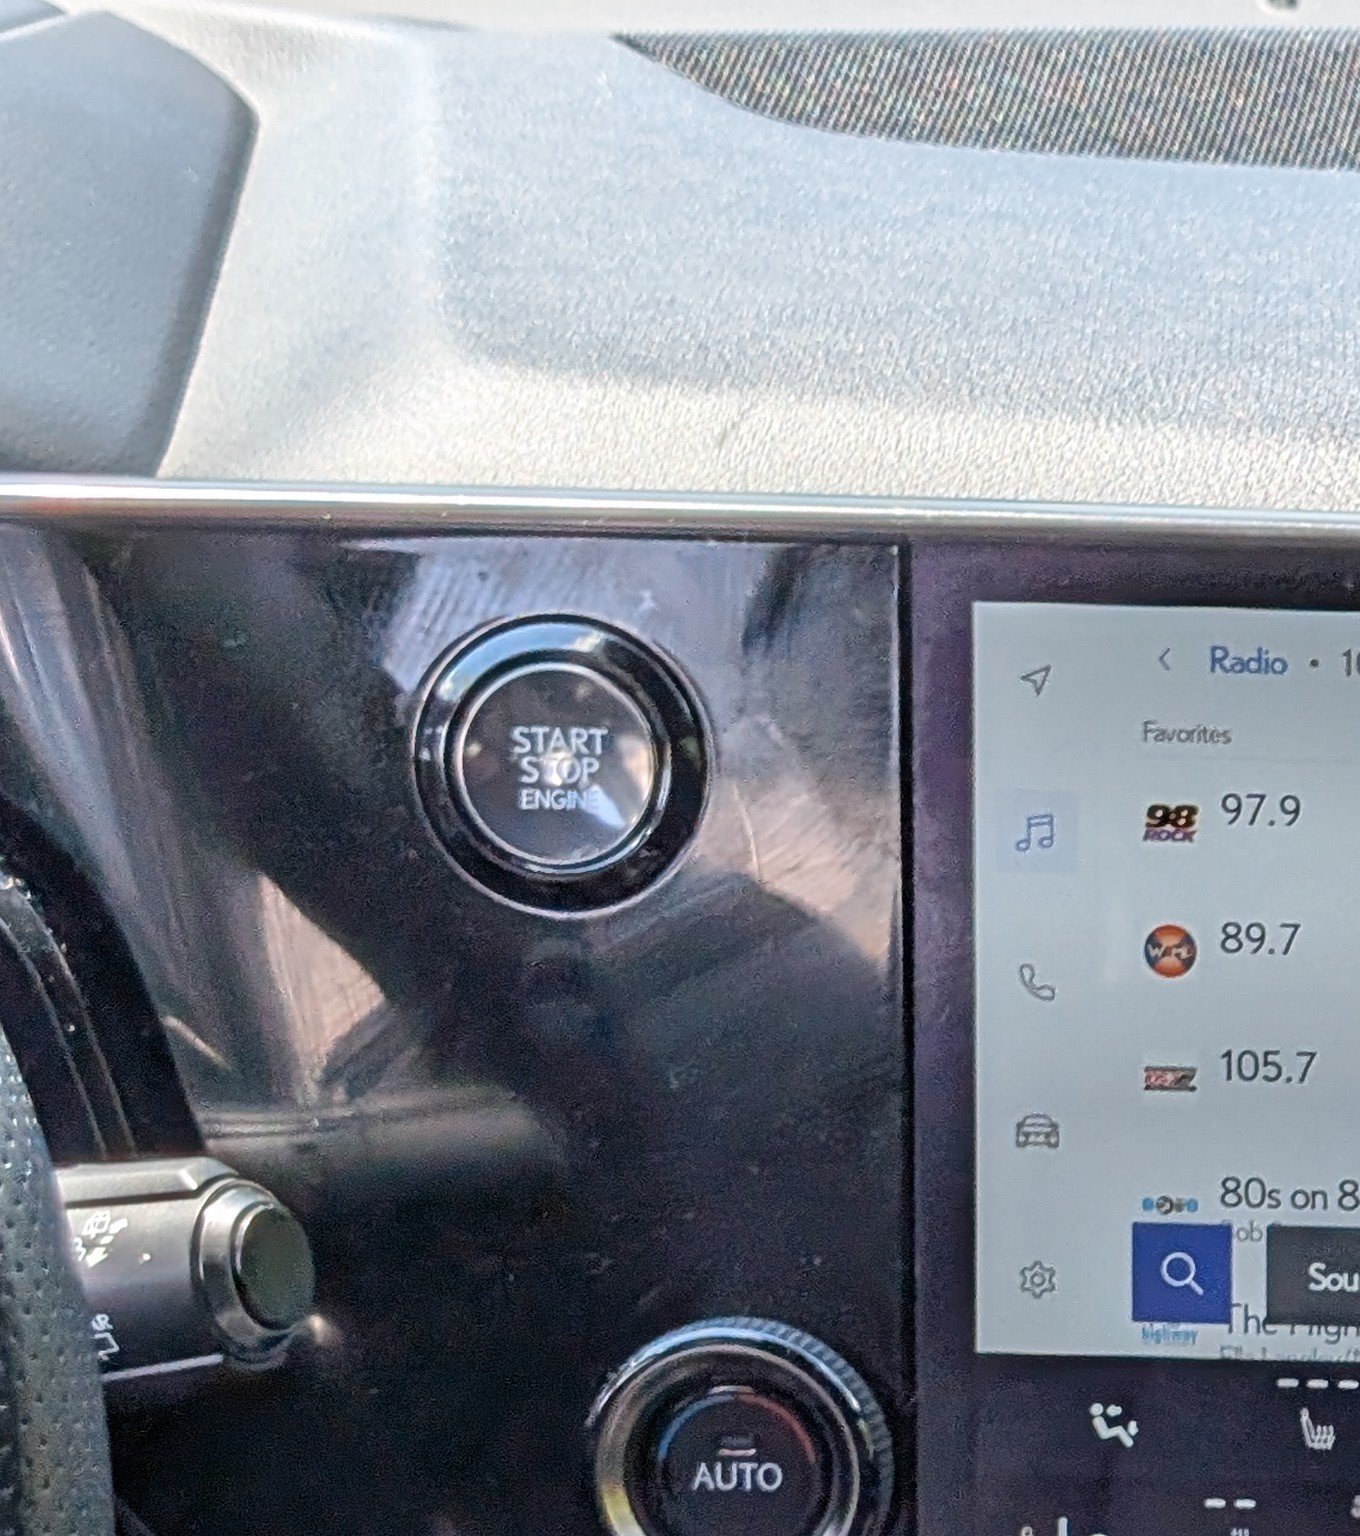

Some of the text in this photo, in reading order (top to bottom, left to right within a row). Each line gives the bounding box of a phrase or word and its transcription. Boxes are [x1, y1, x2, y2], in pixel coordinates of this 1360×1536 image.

[1209, 645, 1289, 678] Radio
[511, 726, 608, 754] START
[1142, 720, 1232, 746] Favorites
[520, 756, 601, 784] STOP
[519, 788, 601, 811] ENGINE
[1220, 793, 1301, 827] 97.9
[1220, 921, 1301, 956] 89.7
[1220, 1049, 1317, 1085] 105.7
[1220, 1176, 1282, 1211] 80s
[1290, 1188, 1329, 1210] on
[1337, 1179, 1360, 1213] 8
[692, 1461, 784, 1492] AUTO
